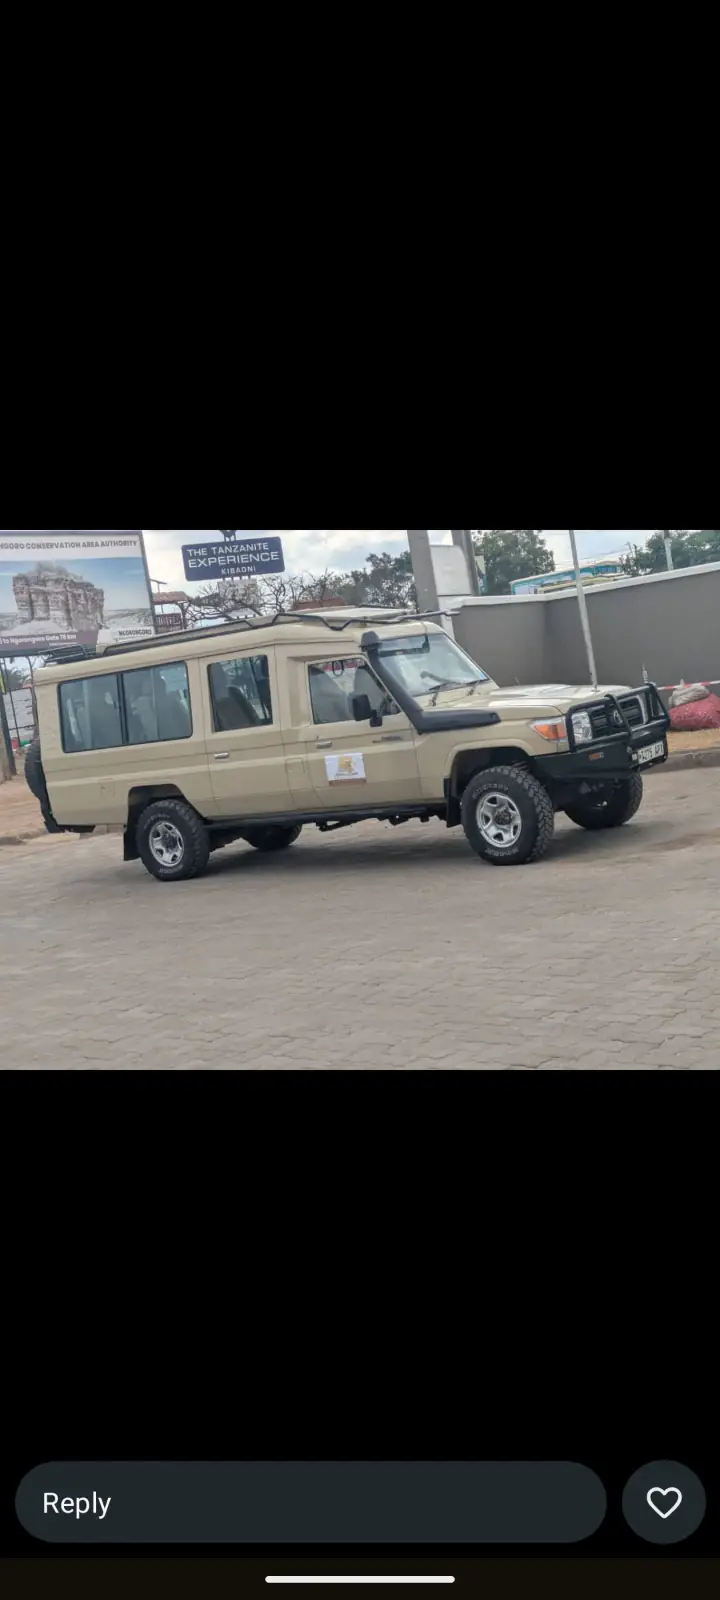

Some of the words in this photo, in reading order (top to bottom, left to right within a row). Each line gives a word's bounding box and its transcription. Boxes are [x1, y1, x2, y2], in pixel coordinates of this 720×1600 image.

[26, 541, 80, 550] CONSERVATION
[101, 539, 137, 547] AUTHORITY
[186, 547, 208, 557] THE
[211, 542, 269, 555] TANZANITE
[188, 551, 280, 569] EXPERIENCE
[221, 565, 256, 575] KIBAONI
